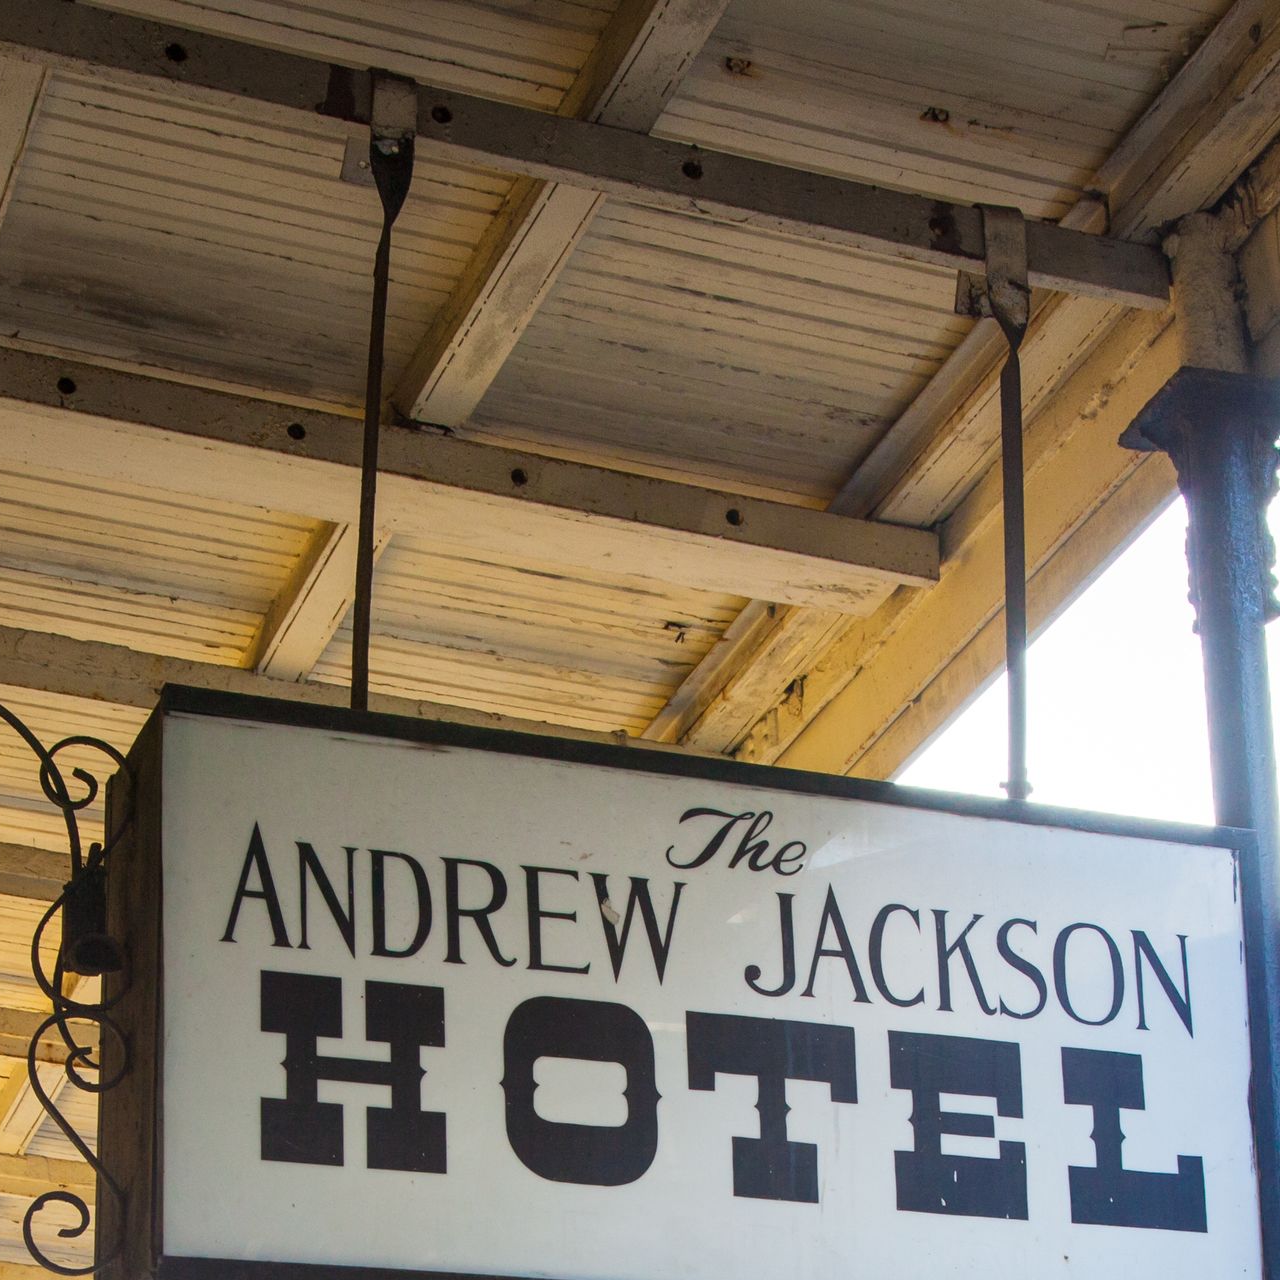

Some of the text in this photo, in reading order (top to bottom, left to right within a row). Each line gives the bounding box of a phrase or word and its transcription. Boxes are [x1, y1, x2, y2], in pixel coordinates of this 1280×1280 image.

[220, 821, 1195, 1038] ANDREW JACKSON
[666, 807, 809, 877] The
[259, 969, 1208, 1232] HOTEL
